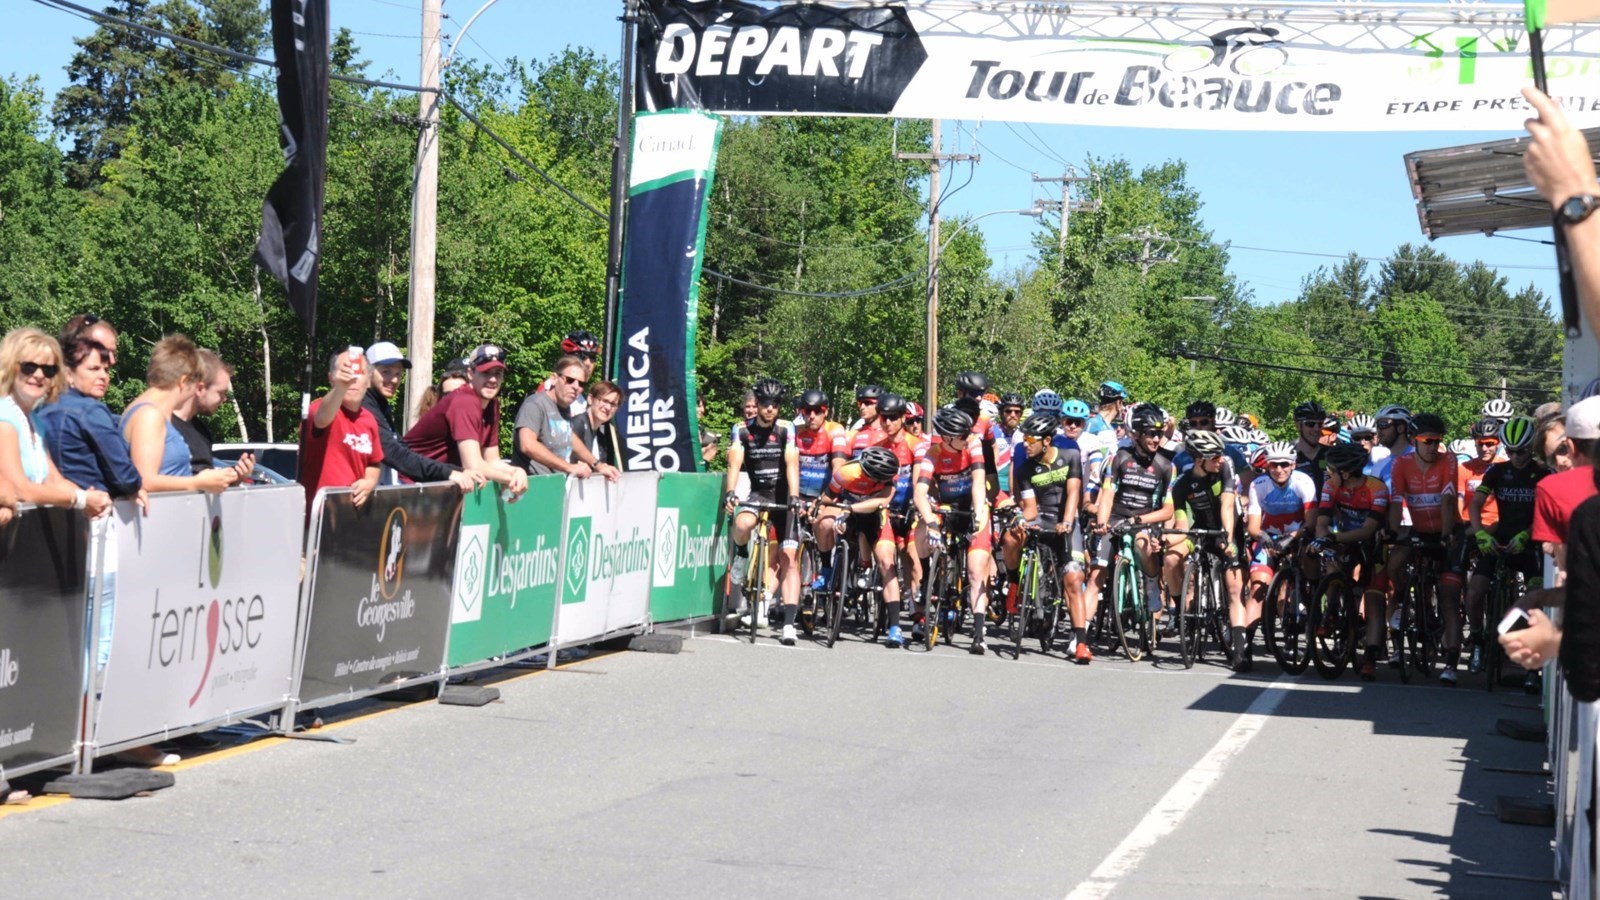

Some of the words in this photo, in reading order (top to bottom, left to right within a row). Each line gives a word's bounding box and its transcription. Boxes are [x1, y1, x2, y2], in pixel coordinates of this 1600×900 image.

[655, 12, 884, 78] DÉPART
[965, 59, 1095, 104] Tour
[1083, 87, 1109, 106] de
[1113, 65, 1342, 116] Beauce
[1386, 97, 1463, 115] ÉTAPE
[639, 134, 697, 153] Canad
[626, 326, 652, 470] MERICA
[652, 395, 680, 472] OUR
[488, 535, 559, 609] Desjardins
[591, 527, 650, 592] Desjardins
[678, 524, 728, 581] Desjardins
[357, 590, 415, 643] Georgesville
